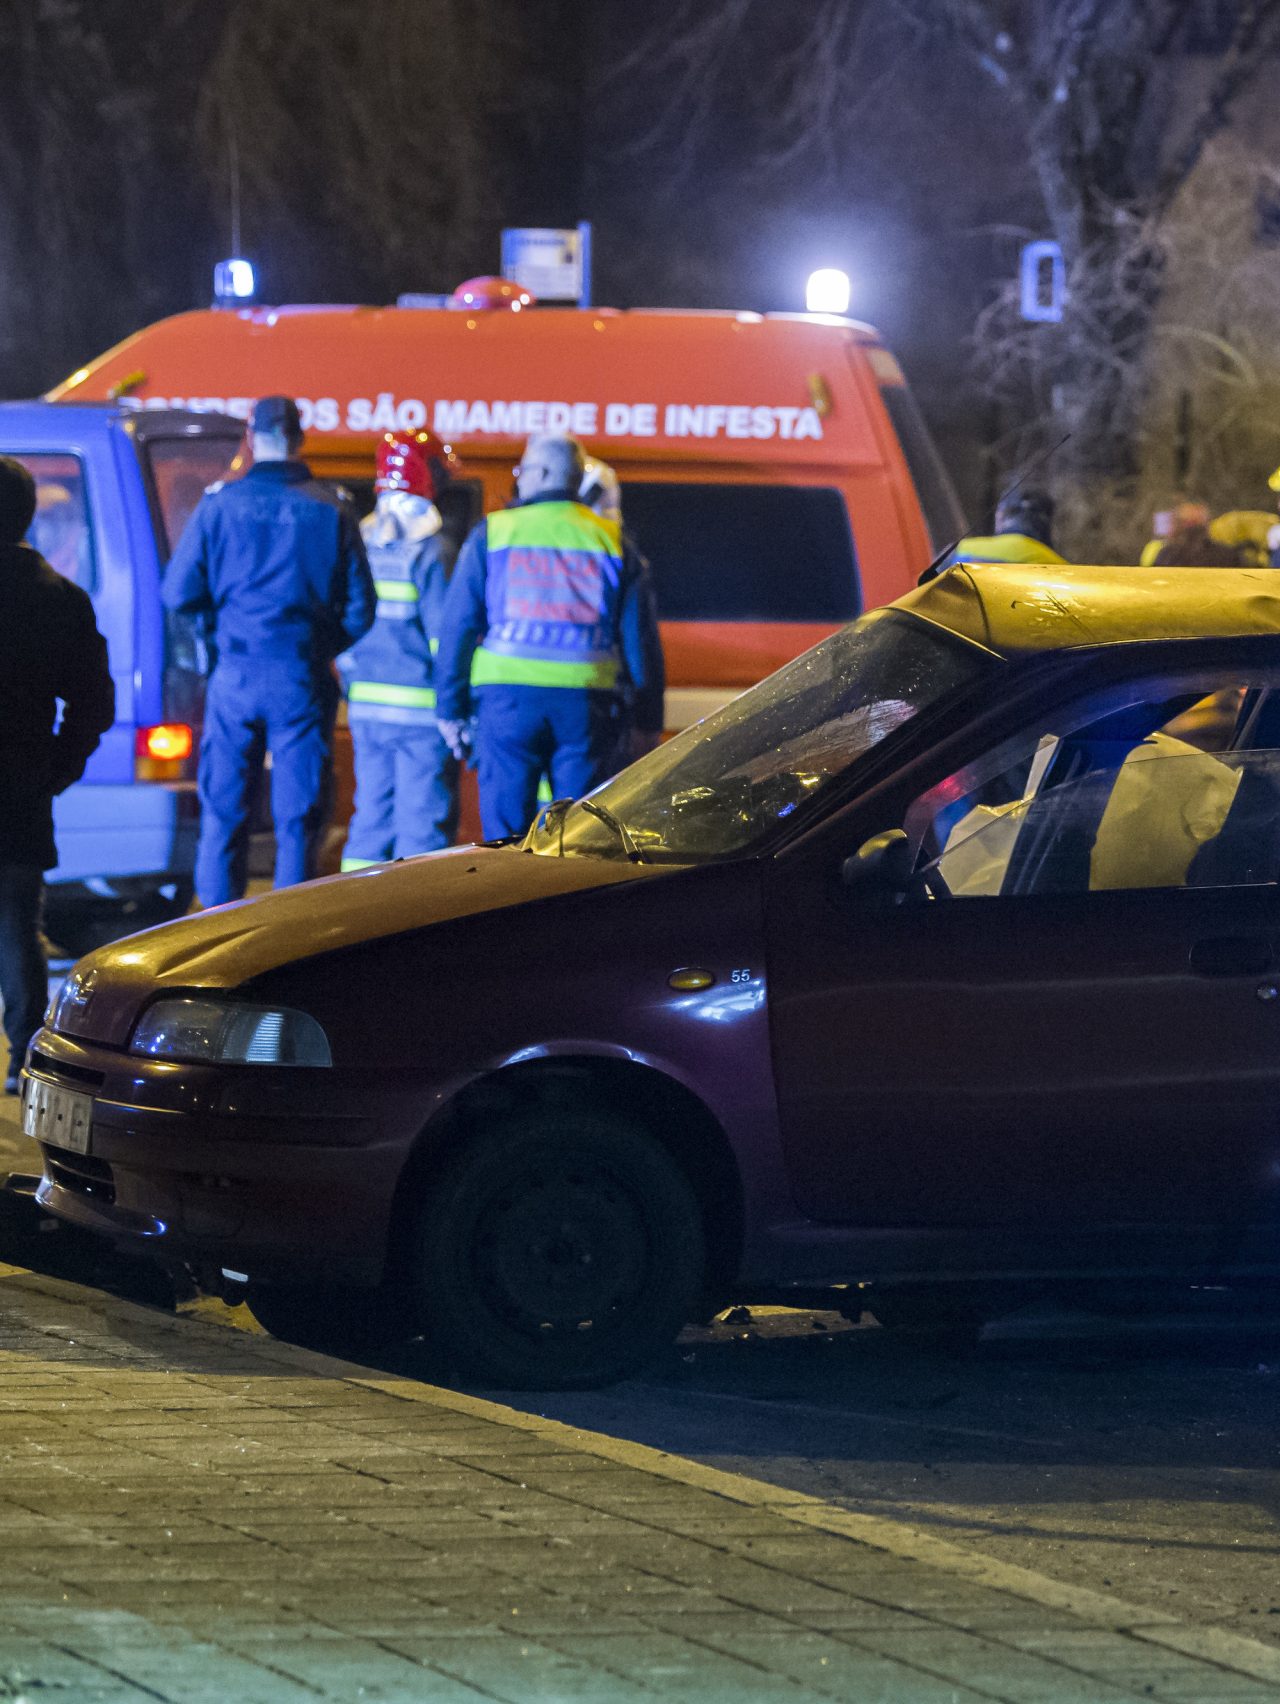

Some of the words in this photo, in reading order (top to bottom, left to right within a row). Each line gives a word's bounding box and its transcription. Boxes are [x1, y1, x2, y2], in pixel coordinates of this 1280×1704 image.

[347, 392, 427, 431] SÃO
[434, 400, 597, 434] MAMEDE
[605, 403, 657, 436] DE
[664, 404, 823, 440] INFESTA
[731, 968, 751, 983] 55
